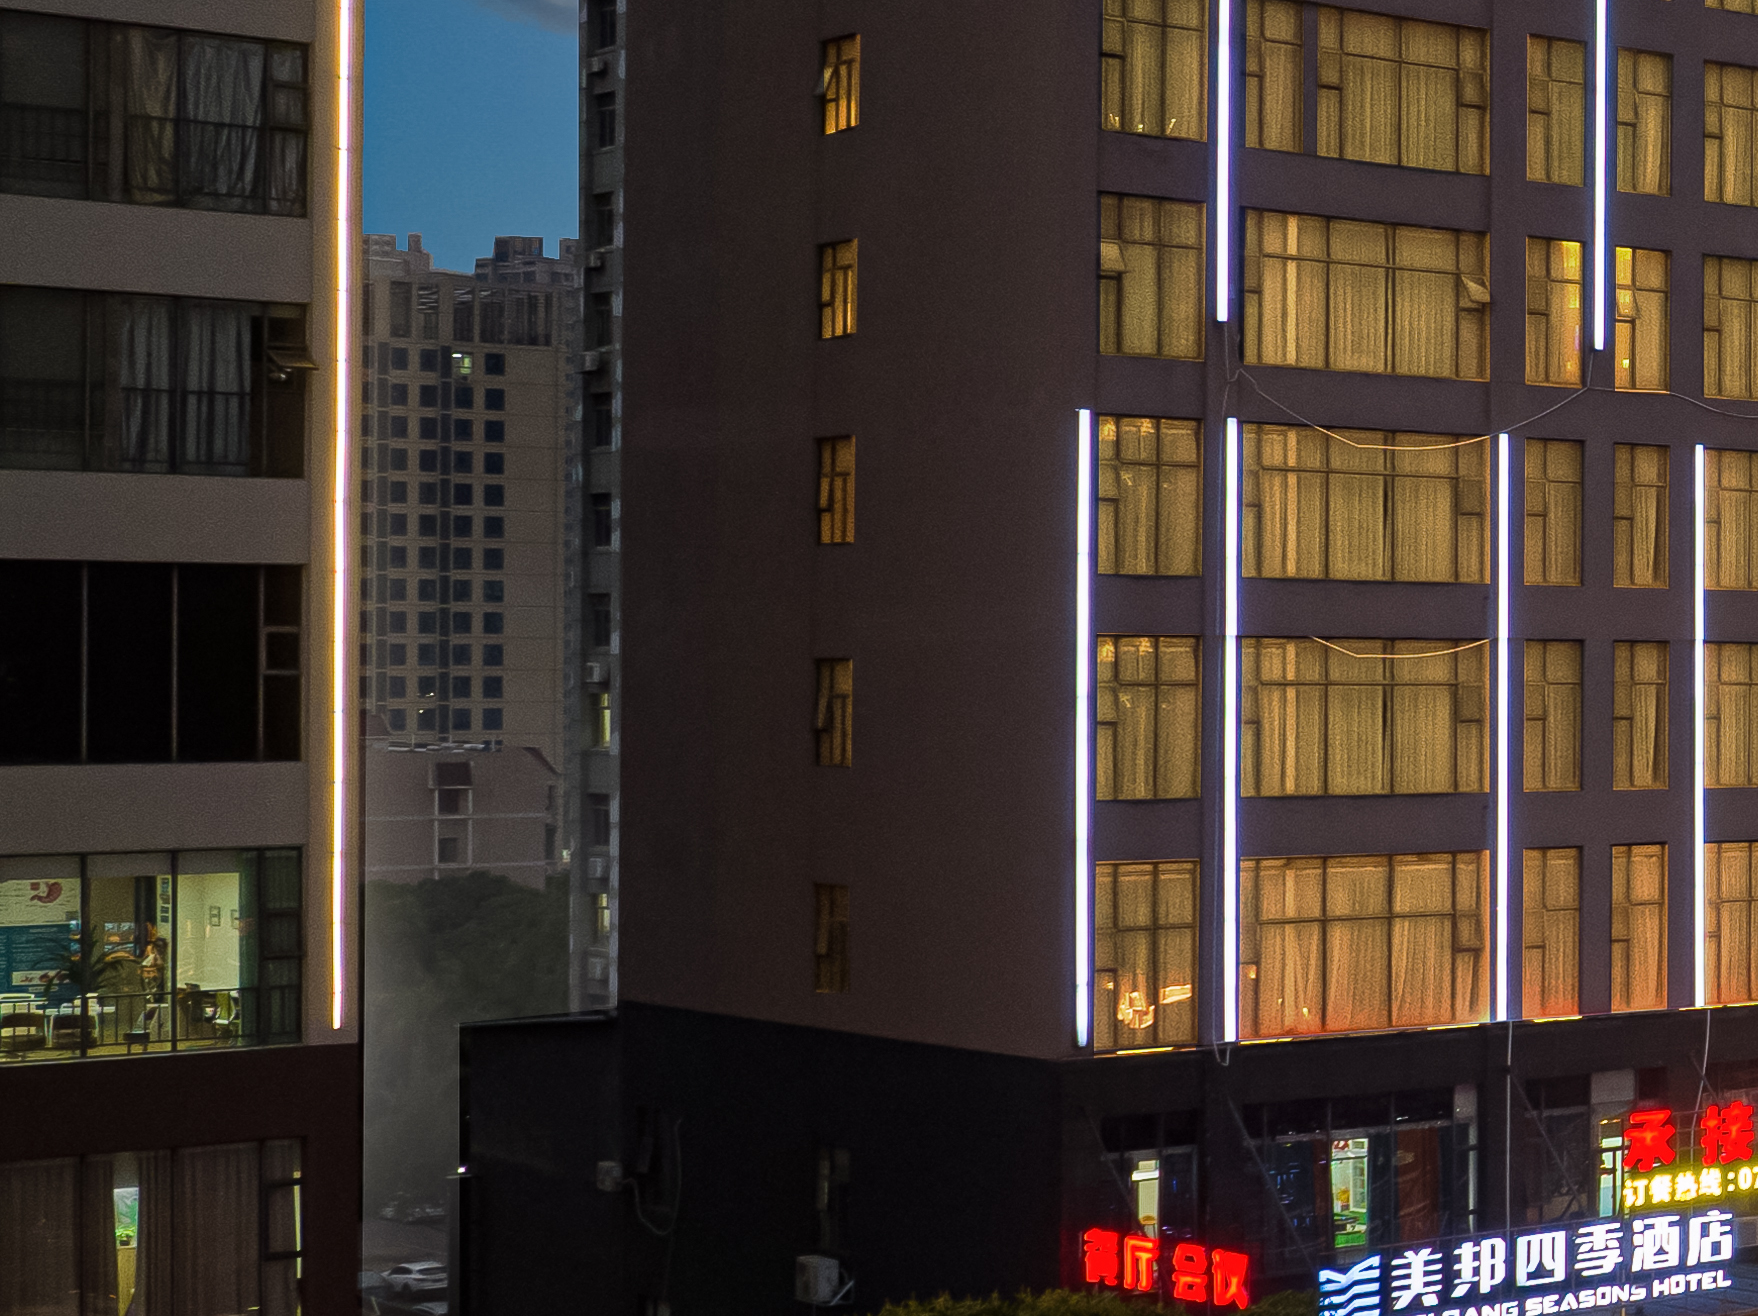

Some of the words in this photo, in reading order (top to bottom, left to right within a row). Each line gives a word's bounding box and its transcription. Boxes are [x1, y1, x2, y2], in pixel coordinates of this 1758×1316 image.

[1083, 1227, 1160, 1292] 餐厅
[1171, 1242, 1250, 1310] 会议
[1389, 1209, 1734, 1310] 美邦四季酒店
[1653, 1271, 1732, 1296] HOTEL
